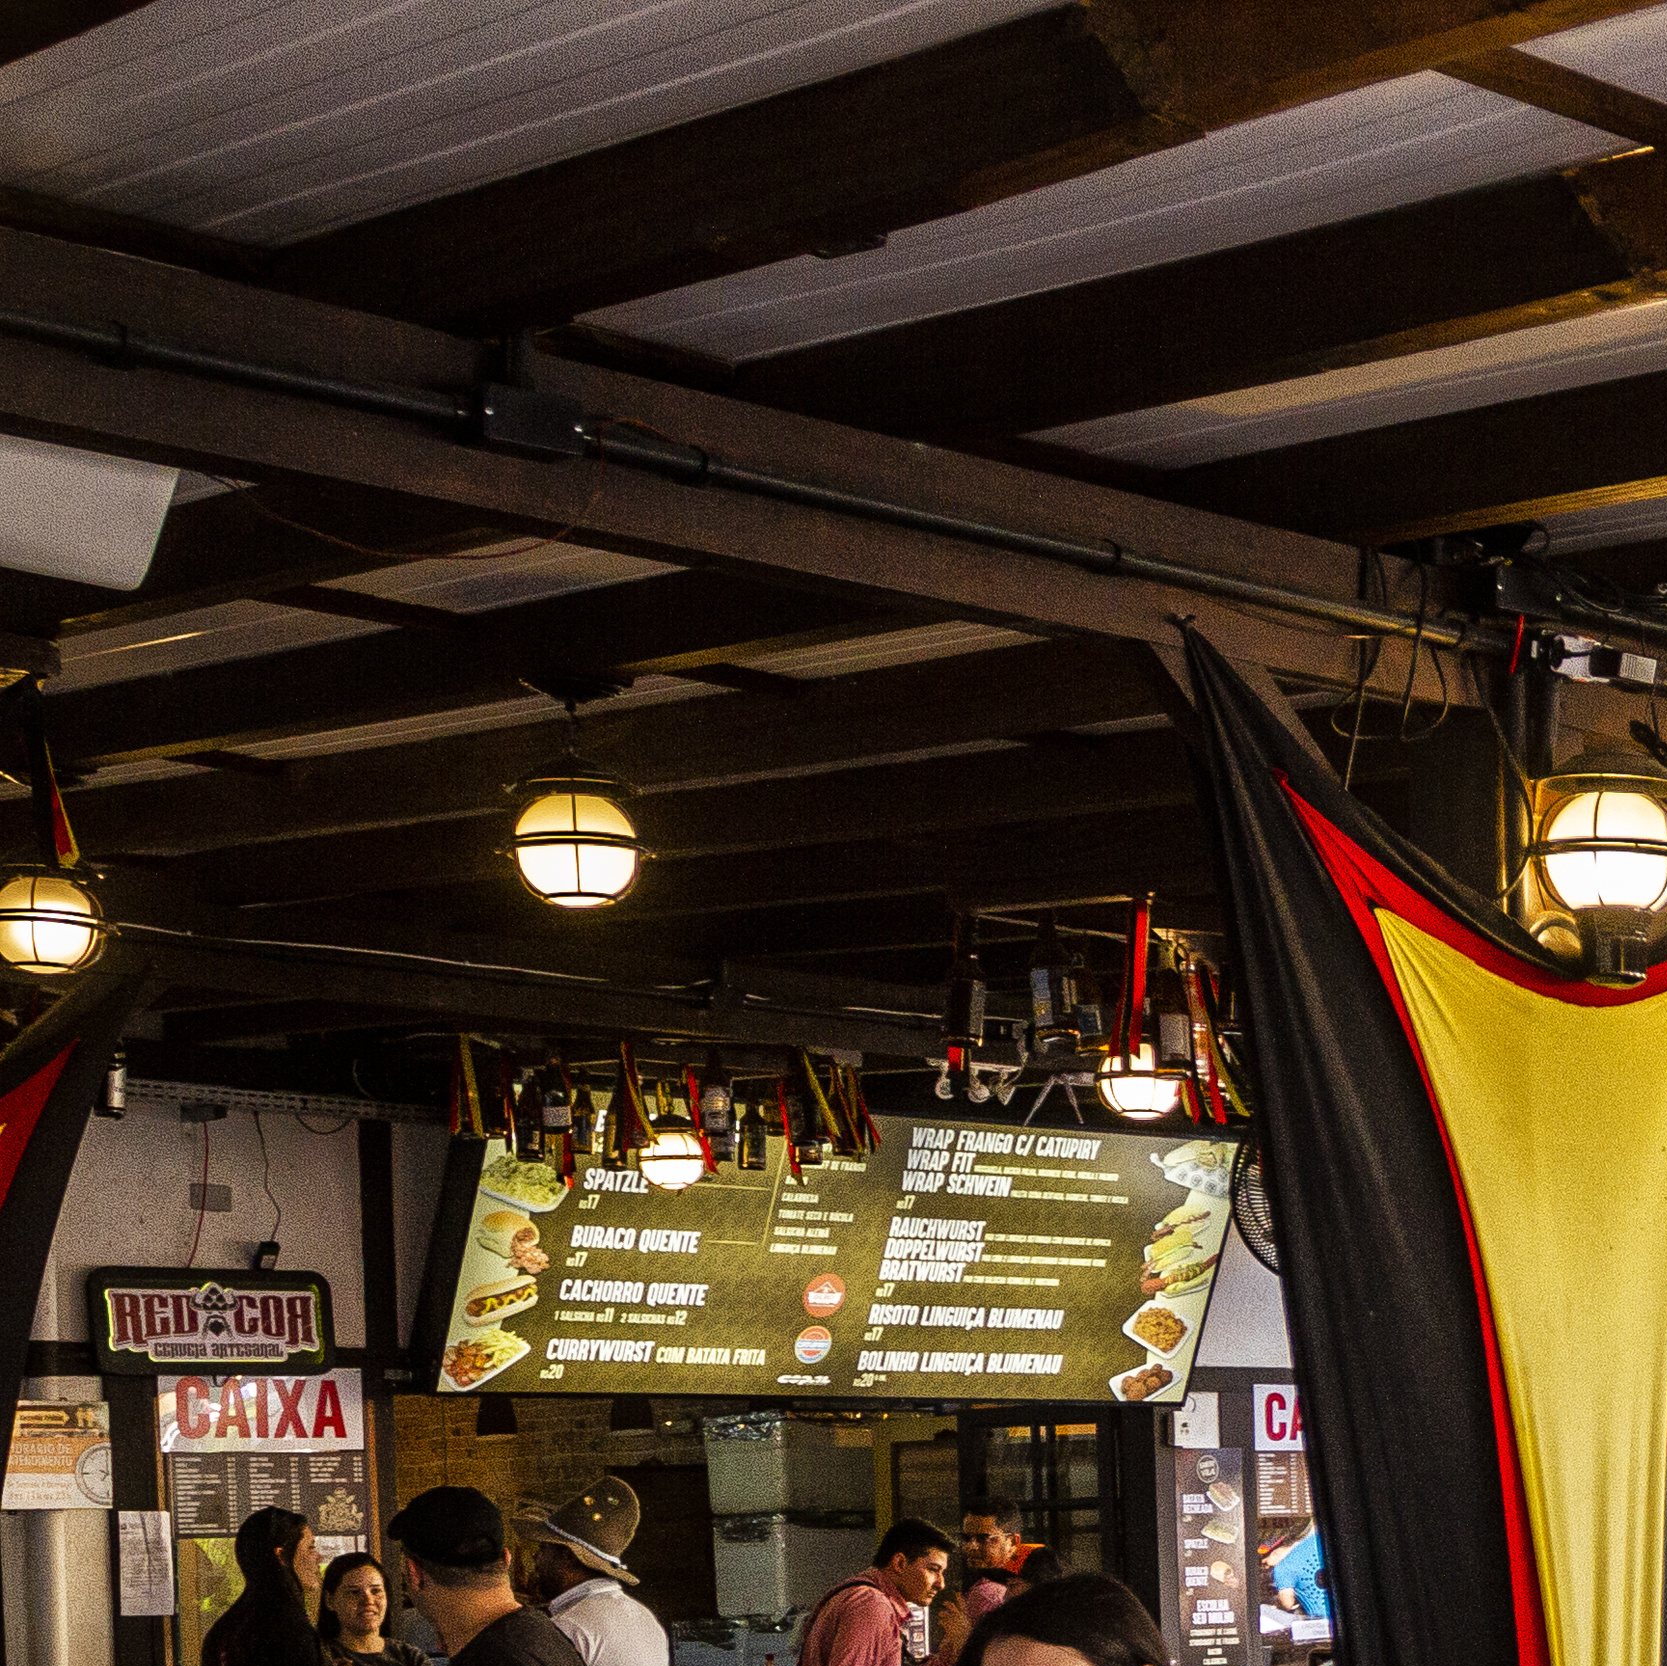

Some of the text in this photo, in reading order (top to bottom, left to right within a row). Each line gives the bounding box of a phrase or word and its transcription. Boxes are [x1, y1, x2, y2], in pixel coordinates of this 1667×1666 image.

[911, 1127, 1102, 1160] WRAP FRANGO C/ CATUPIRY
[906, 1149, 977, 1173] WRAP FIT
[901, 1171, 944, 1193] WRAP
[946, 1174, 1013, 1198] SCHWEIN
[571, 1225, 701, 1254] BURACO QUENTE
[888, 1216, 987, 1241] RAUCHWURST
[883, 1238, 985, 1262] DOPPELWURST
[878, 1260, 967, 1283] BRATWURST
[560, 1279, 708, 1307] CACHORRO QUENTE
[110, 1293, 199, 1347] RED
[560, 1312, 595, 1322] SALSICHA
[868, 1304, 1065, 1331] RISOTO LINGUIÇA BLUMENAU
[546, 1339, 766, 1366] CURRYWURST COM BATATA FRITA
[857, 1351, 1064, 1376] BOLINHO LINGUIÇA BLUMENAU
[176, 1376, 348, 1439] CAIXA
